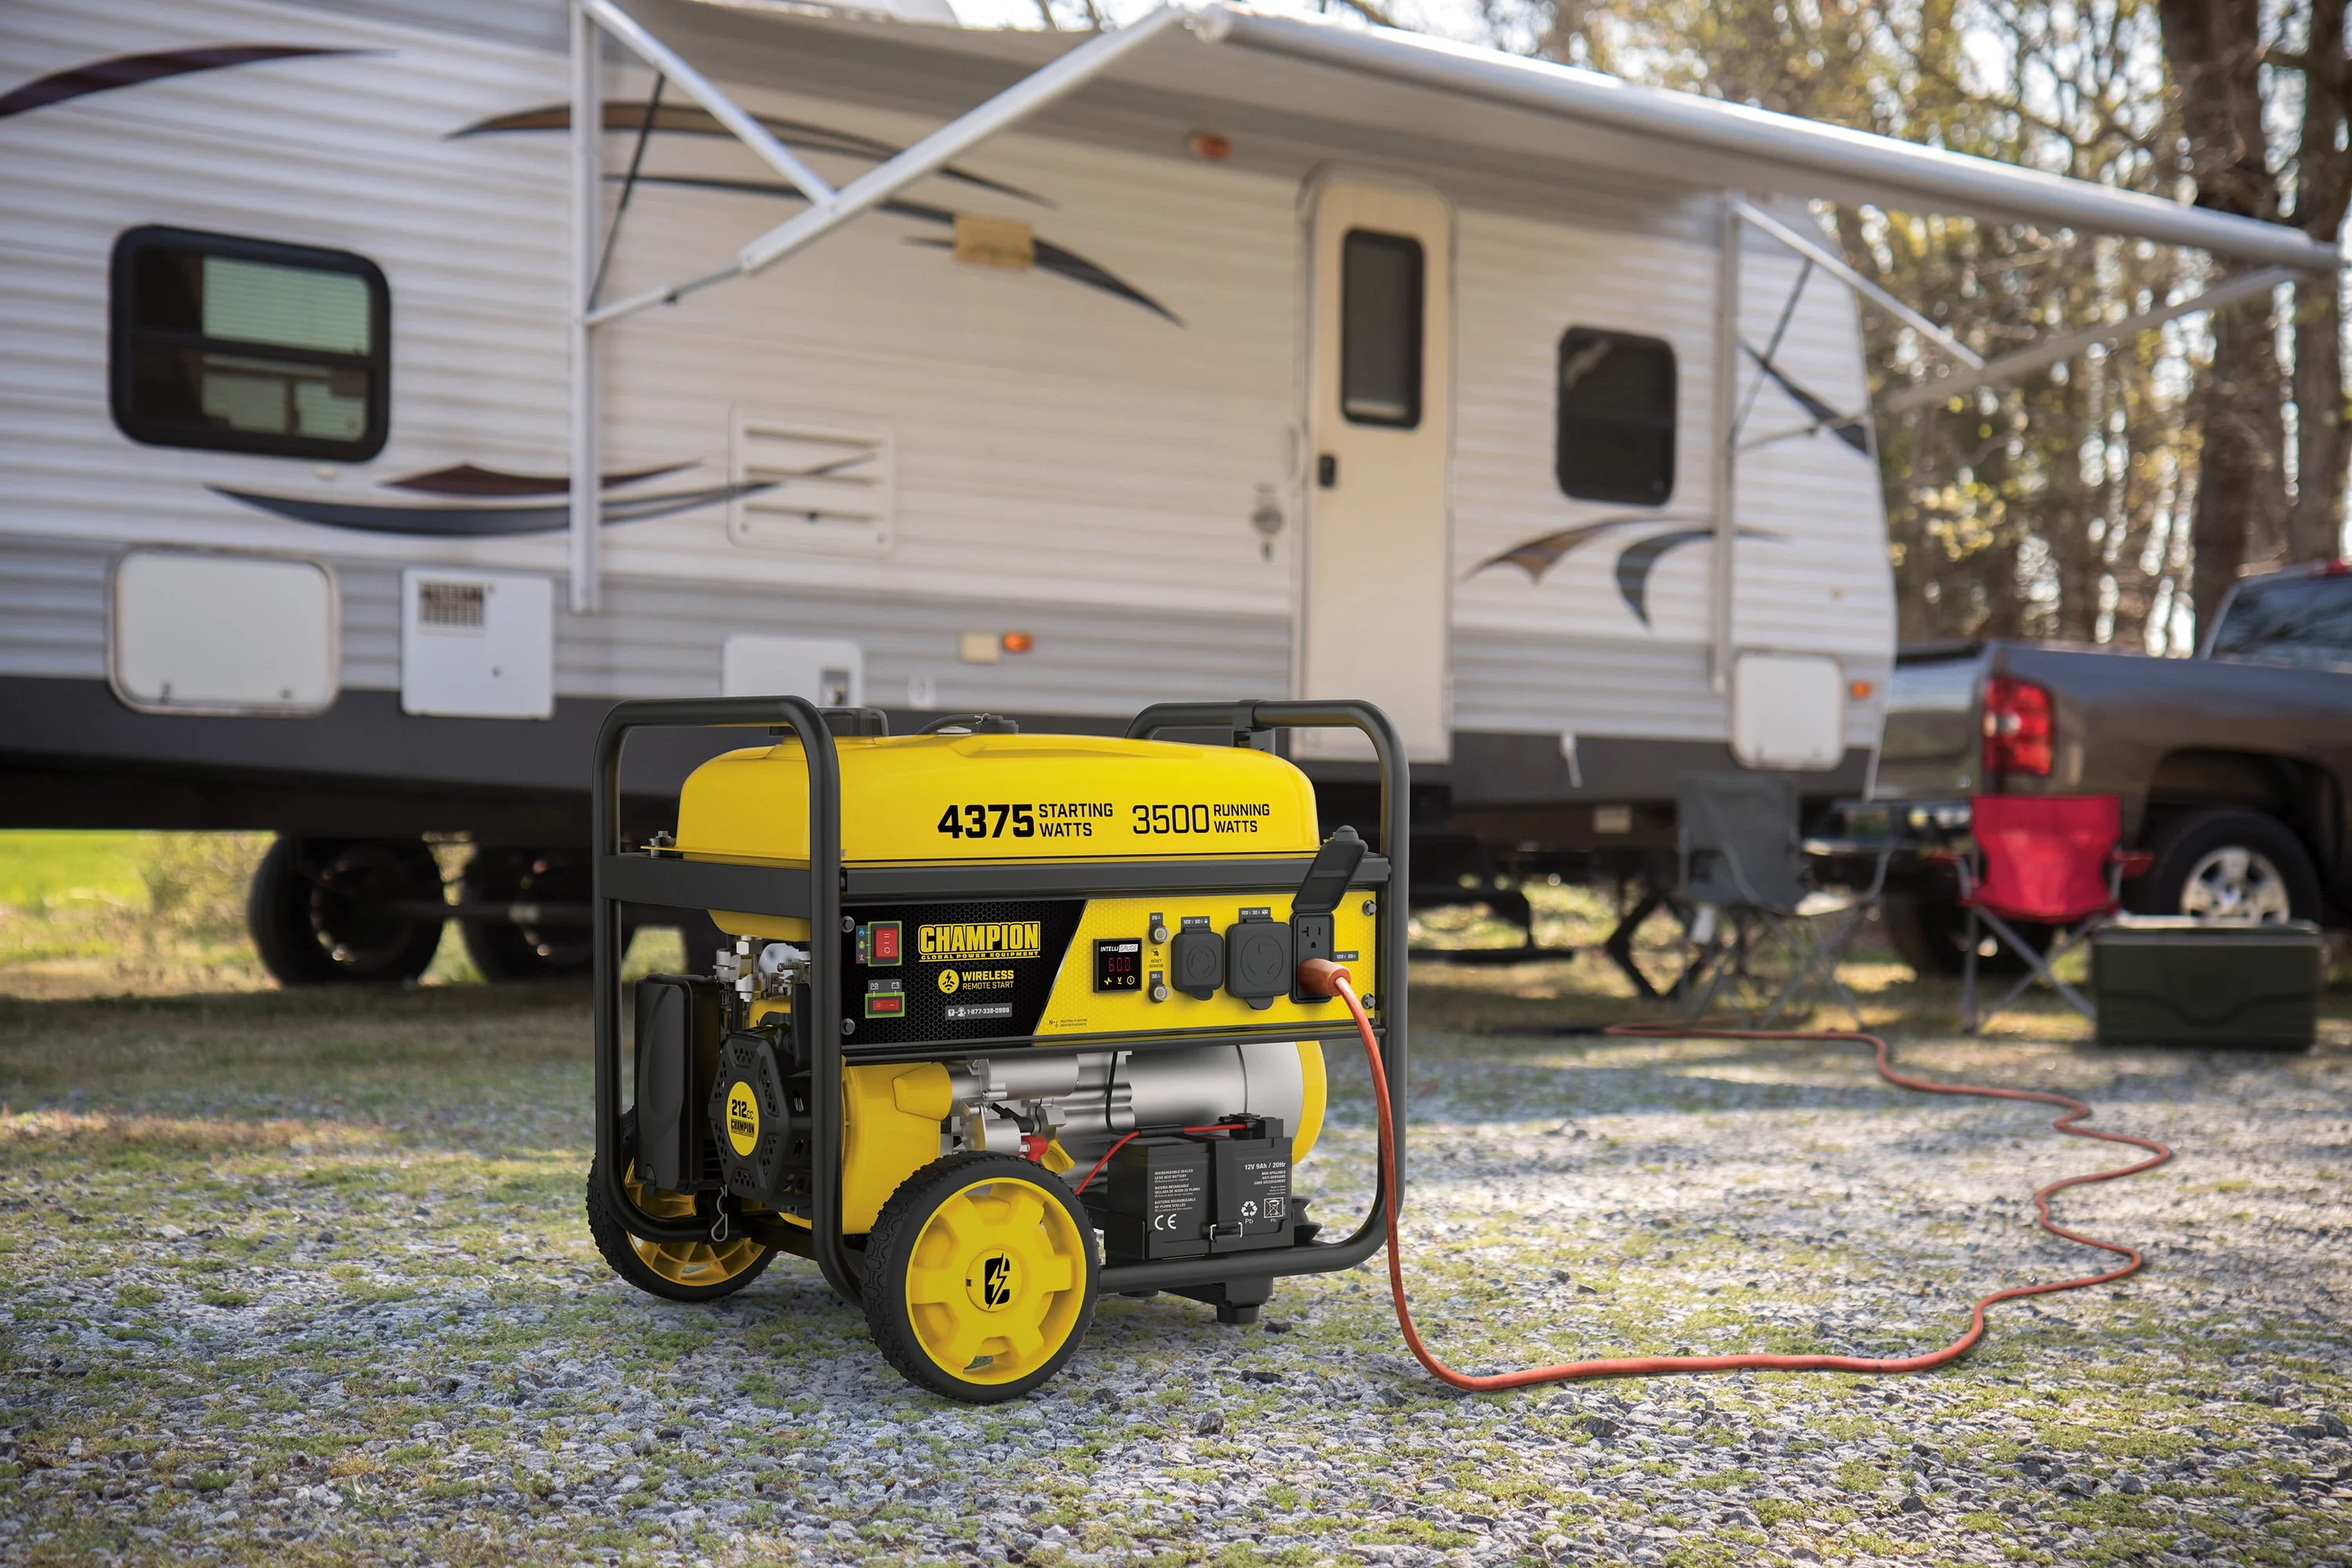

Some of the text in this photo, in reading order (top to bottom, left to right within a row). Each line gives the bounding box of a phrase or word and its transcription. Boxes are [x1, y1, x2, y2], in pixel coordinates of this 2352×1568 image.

[1039, 803, 1113, 818] STARTING
[1214, 804, 1270, 817] RUNNING
[937, 804, 1036, 839] 4375
[1132, 804, 1210, 834] 3500
[1214, 820, 1258, 833] WATTS
[1040, 822, 1093, 838] WATTS
[920, 923, 1039, 953] CHAMPION
[962, 969, 1014, 982] WIRELESS
[962, 981, 1014, 990] REMOTE START
[1154, 1214, 1177, 1230] CE
